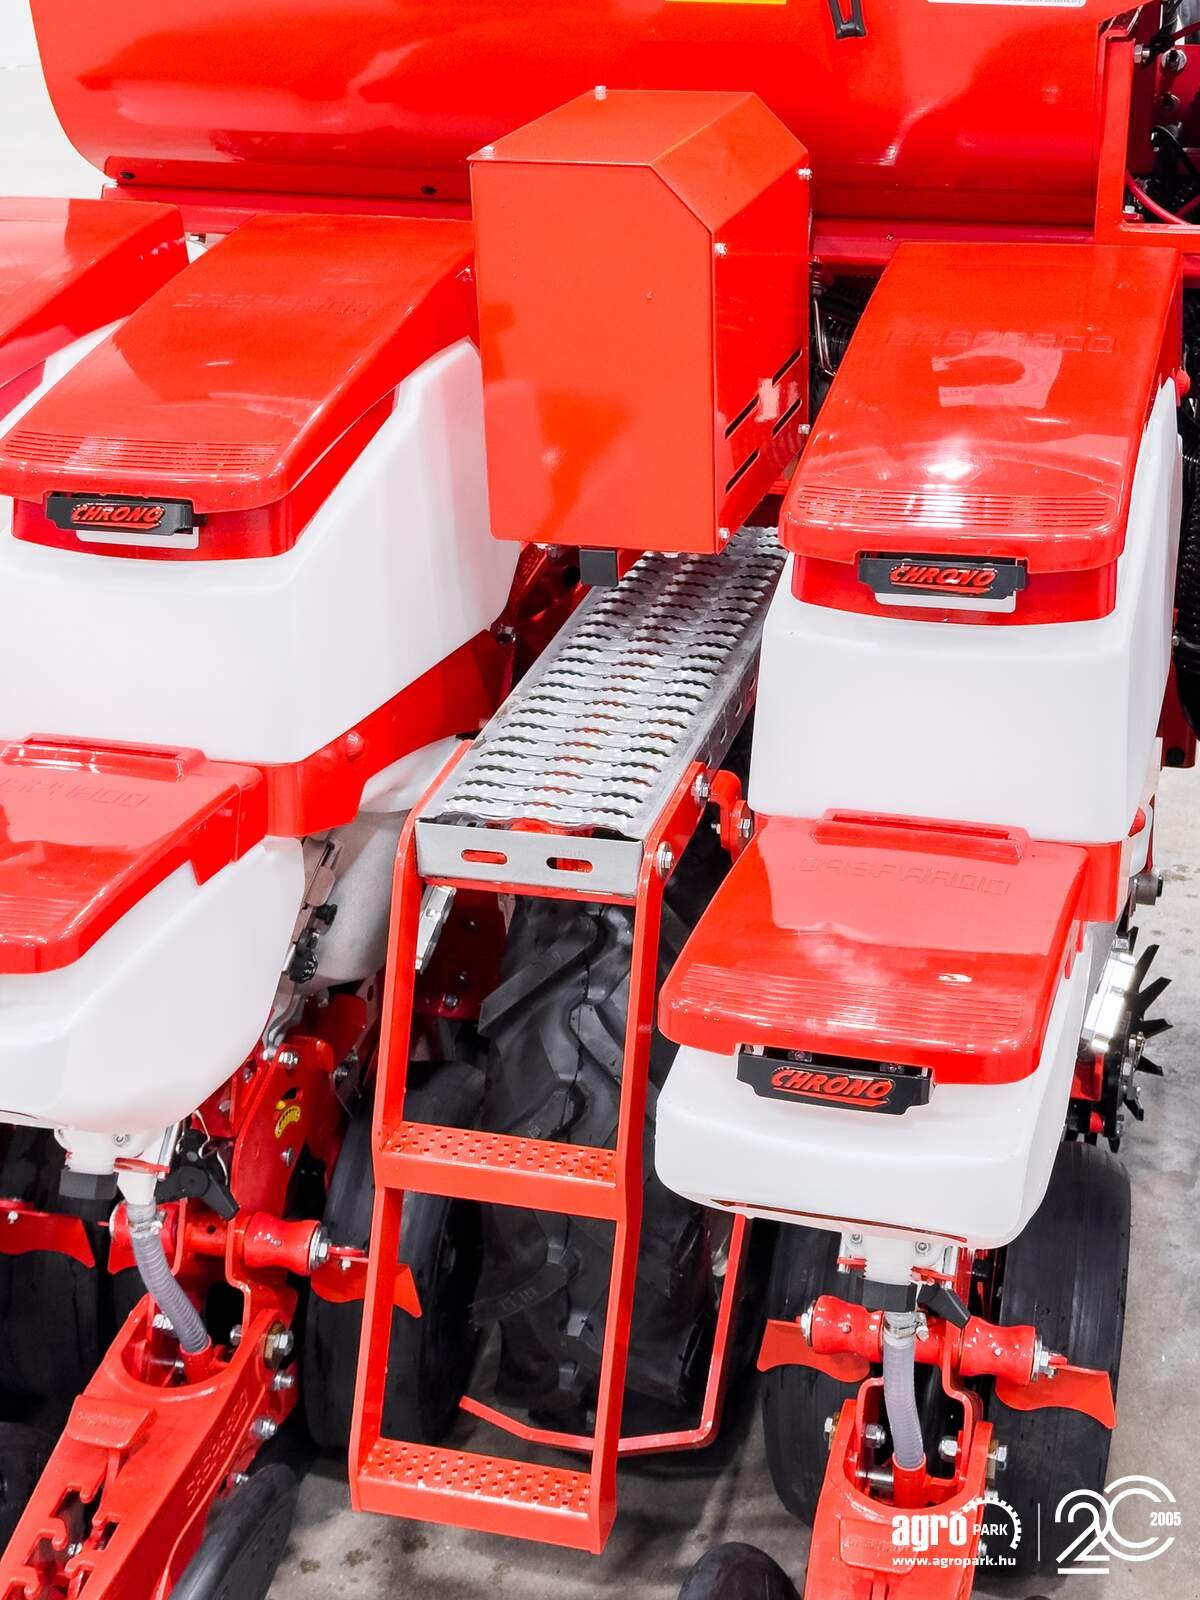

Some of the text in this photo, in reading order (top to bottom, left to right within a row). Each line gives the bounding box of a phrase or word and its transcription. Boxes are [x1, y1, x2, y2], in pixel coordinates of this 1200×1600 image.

[71, 504, 165, 524] CHRONO
[889, 565, 998, 588] CHRONO
[771, 1069, 893, 1100] CHRONO
